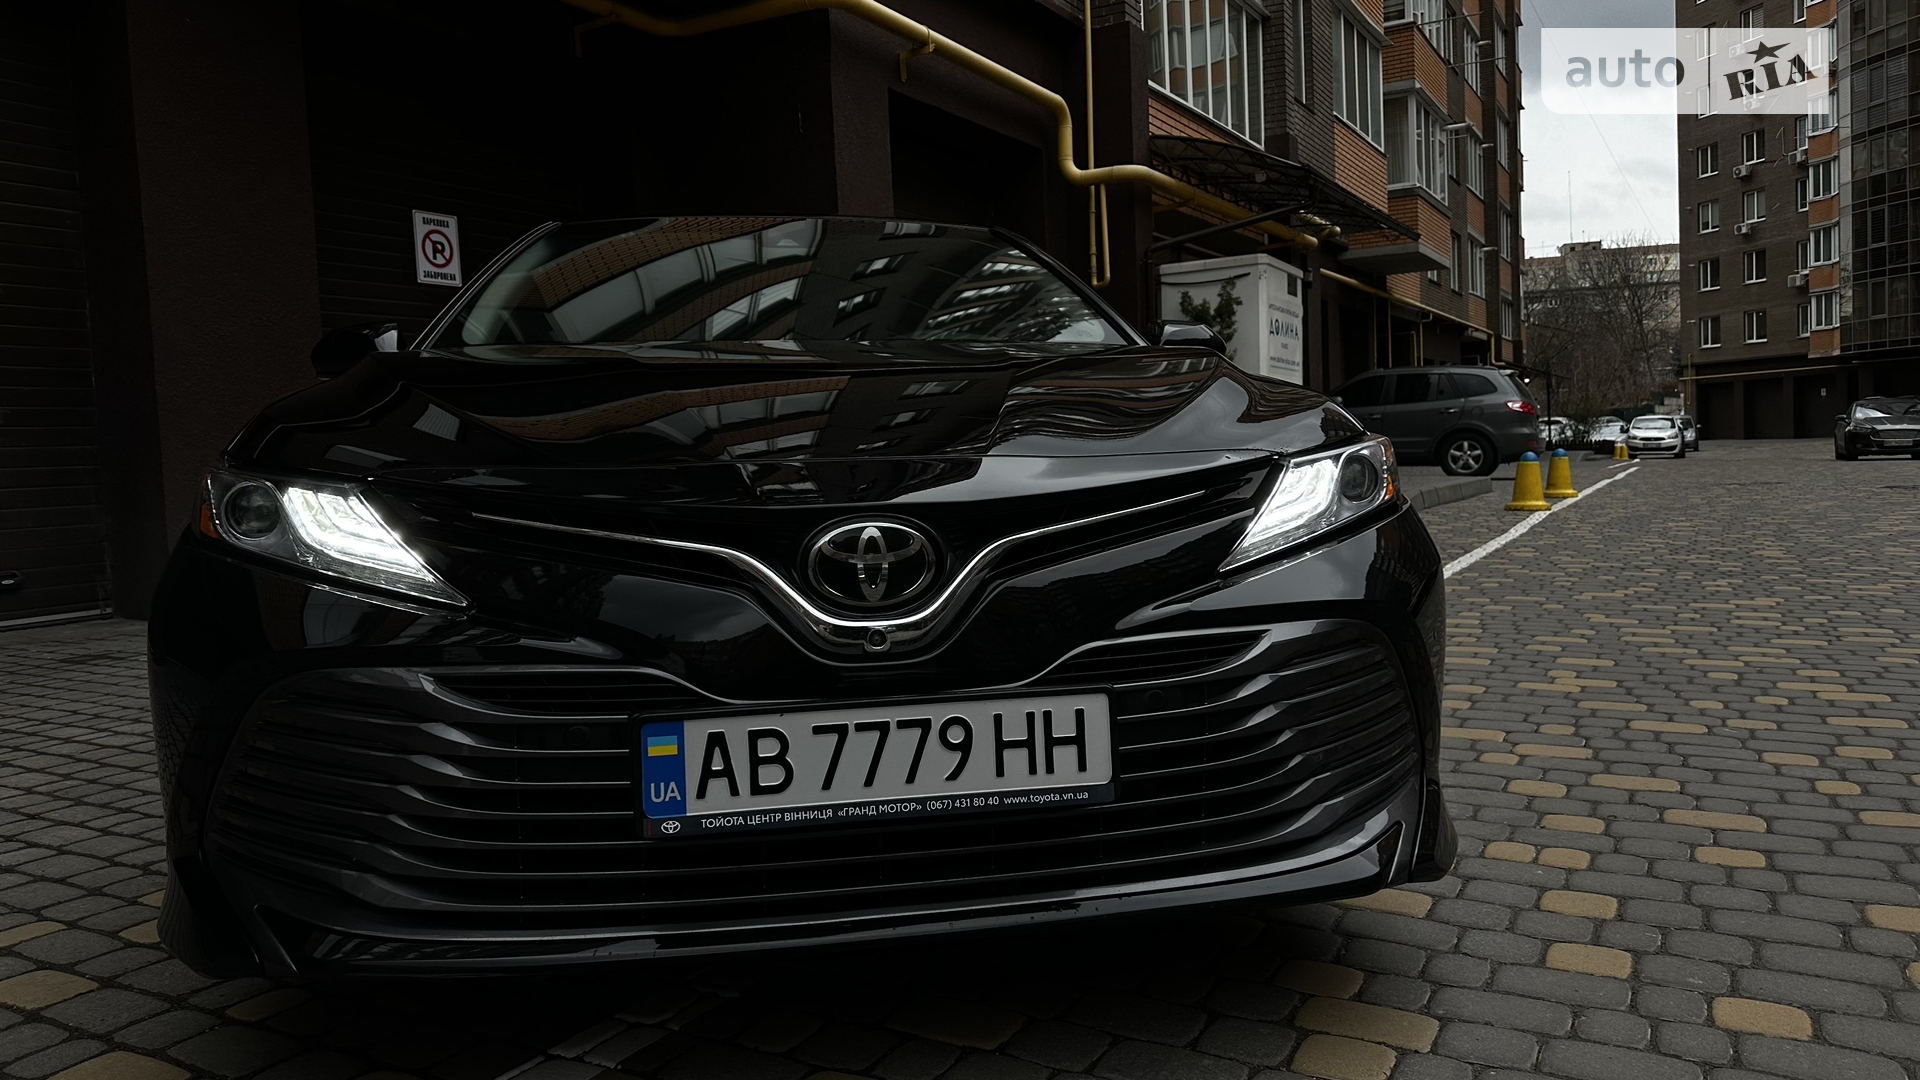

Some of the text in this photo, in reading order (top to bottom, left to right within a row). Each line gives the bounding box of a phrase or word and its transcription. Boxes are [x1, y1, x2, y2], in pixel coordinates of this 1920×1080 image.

[695, 706, 1088, 800] AB 7779 HH
[650, 781, 681, 803] UA
[701, 791, 1089, 829] ТОЙОТА ЦЕНТР ВІННИЦЯ «ГРАНД МОТОР» (067) 431 80 40 www.toyota.vn.ua
